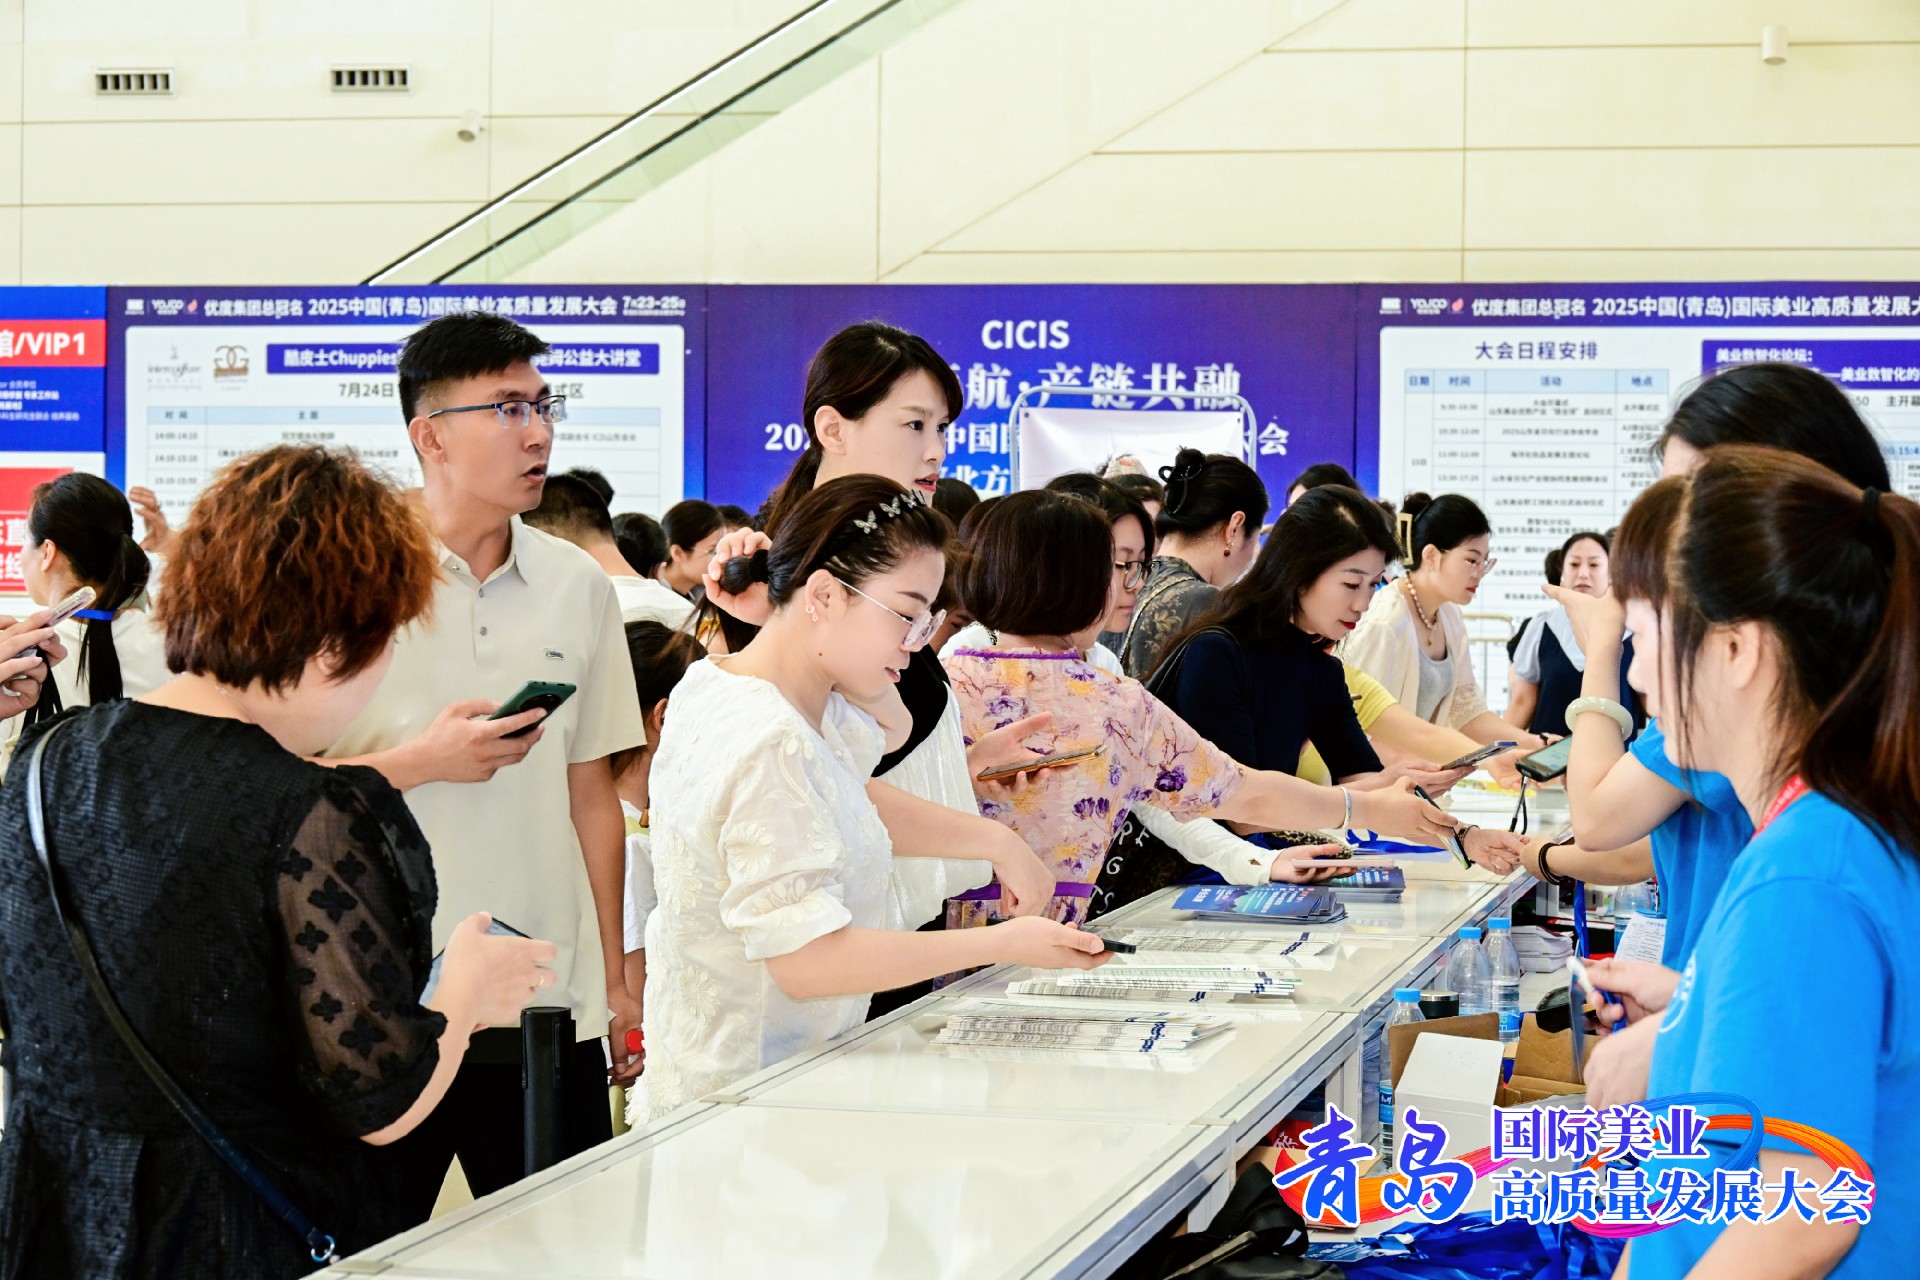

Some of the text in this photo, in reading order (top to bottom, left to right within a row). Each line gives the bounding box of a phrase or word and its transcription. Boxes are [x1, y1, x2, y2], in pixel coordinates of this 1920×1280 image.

[204, 298, 303, 317] 优度集团总冠名
[1471, 298, 1586, 317] 优度集团总冠名
[981, 320, 1070, 349] CICIS
[1475, 341, 1598, 360] 大会日程安排
[339, 383, 584, 398] 7月24日 式区
[1409, 376, 1653, 387] 日期 时间 活动 地点
